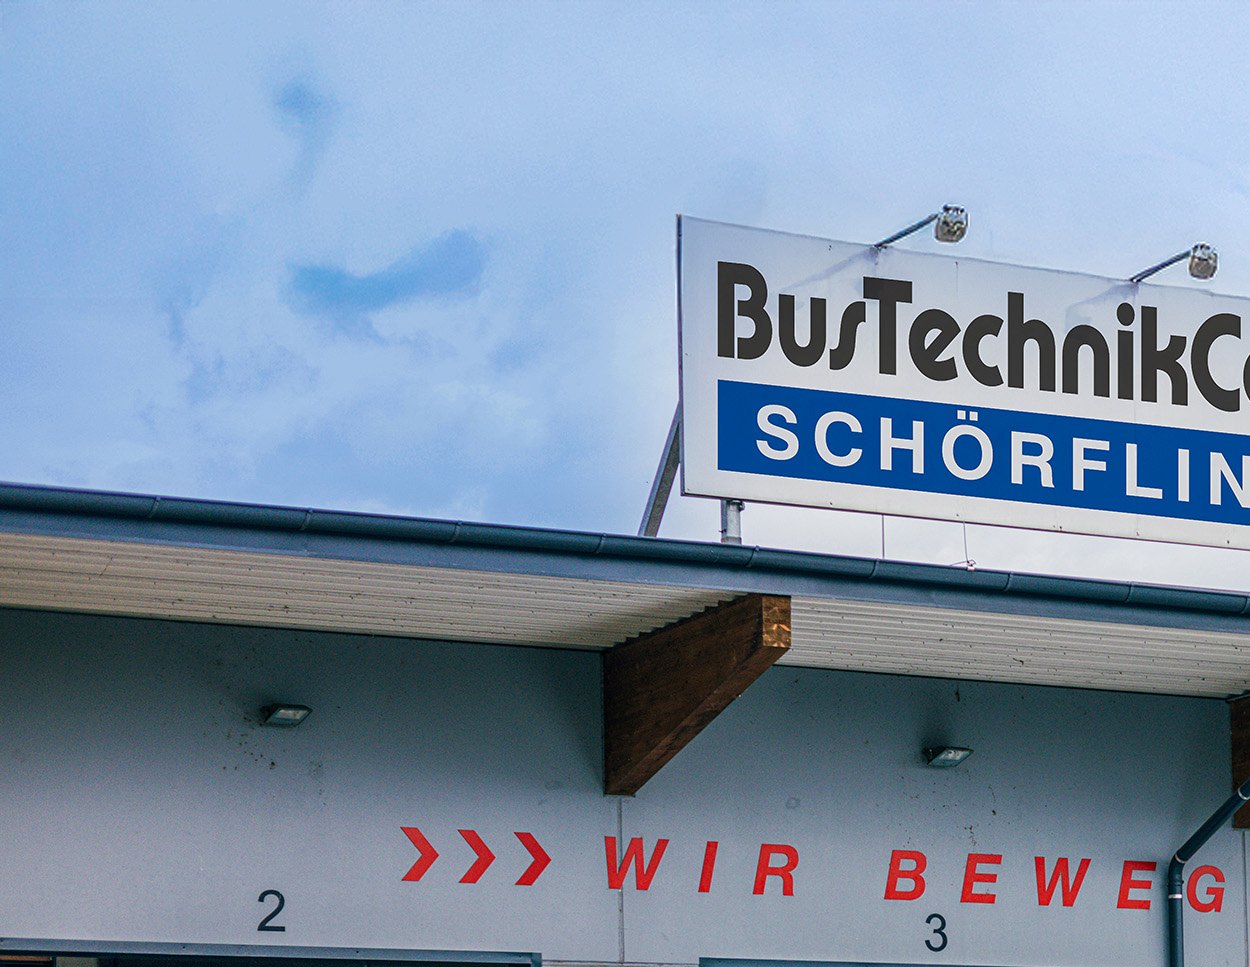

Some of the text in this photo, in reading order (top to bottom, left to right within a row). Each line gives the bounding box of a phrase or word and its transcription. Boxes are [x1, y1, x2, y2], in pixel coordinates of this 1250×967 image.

[605, 835, 800, 898] WIR
[257, 889, 286, 933] 2
[924, 913, 948, 952] 3
